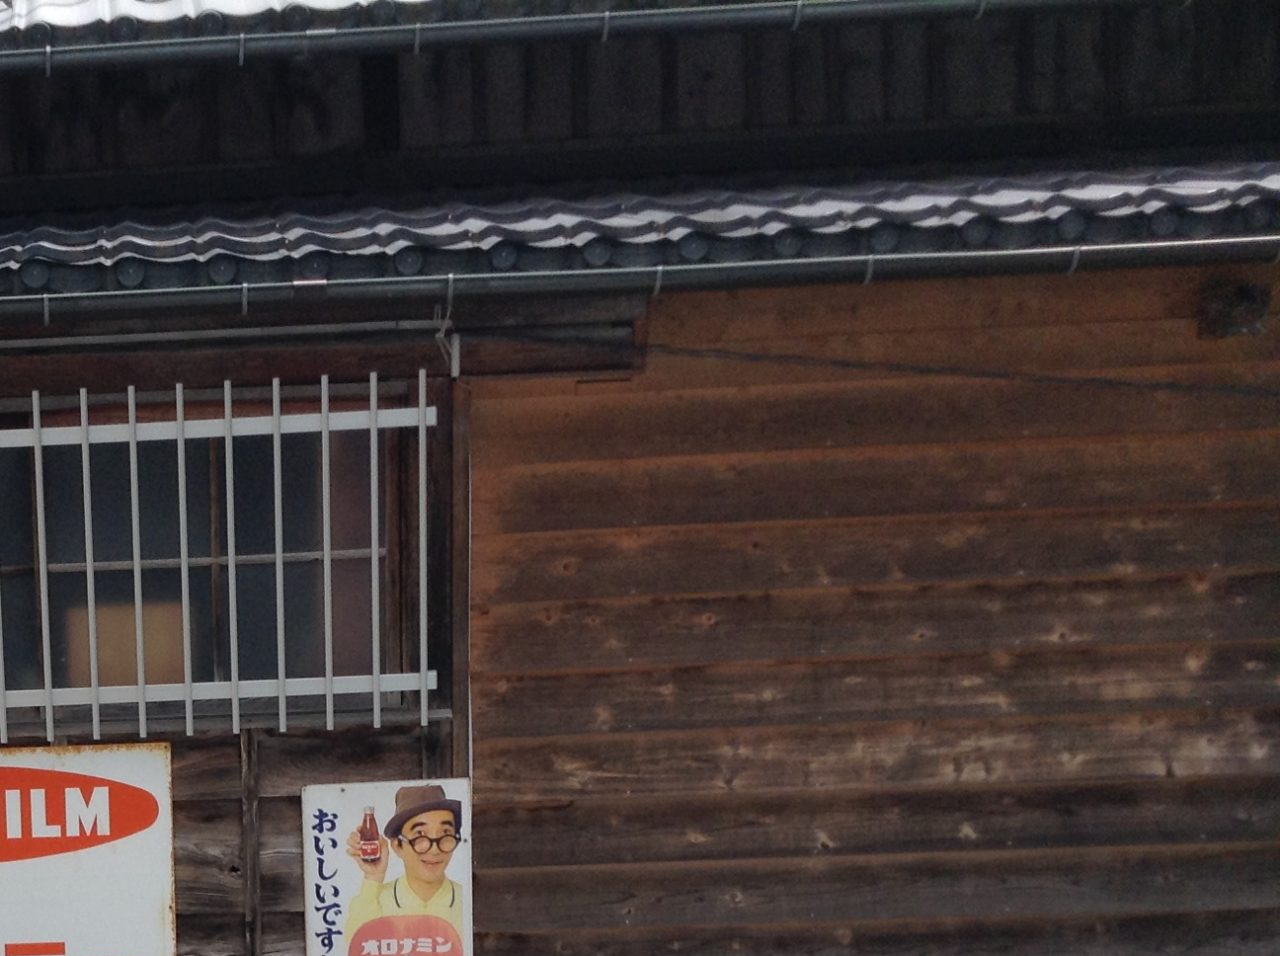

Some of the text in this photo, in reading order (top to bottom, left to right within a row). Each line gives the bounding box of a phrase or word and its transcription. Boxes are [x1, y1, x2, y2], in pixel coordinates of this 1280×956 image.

[360, 937, 453, 956] オロナミン
